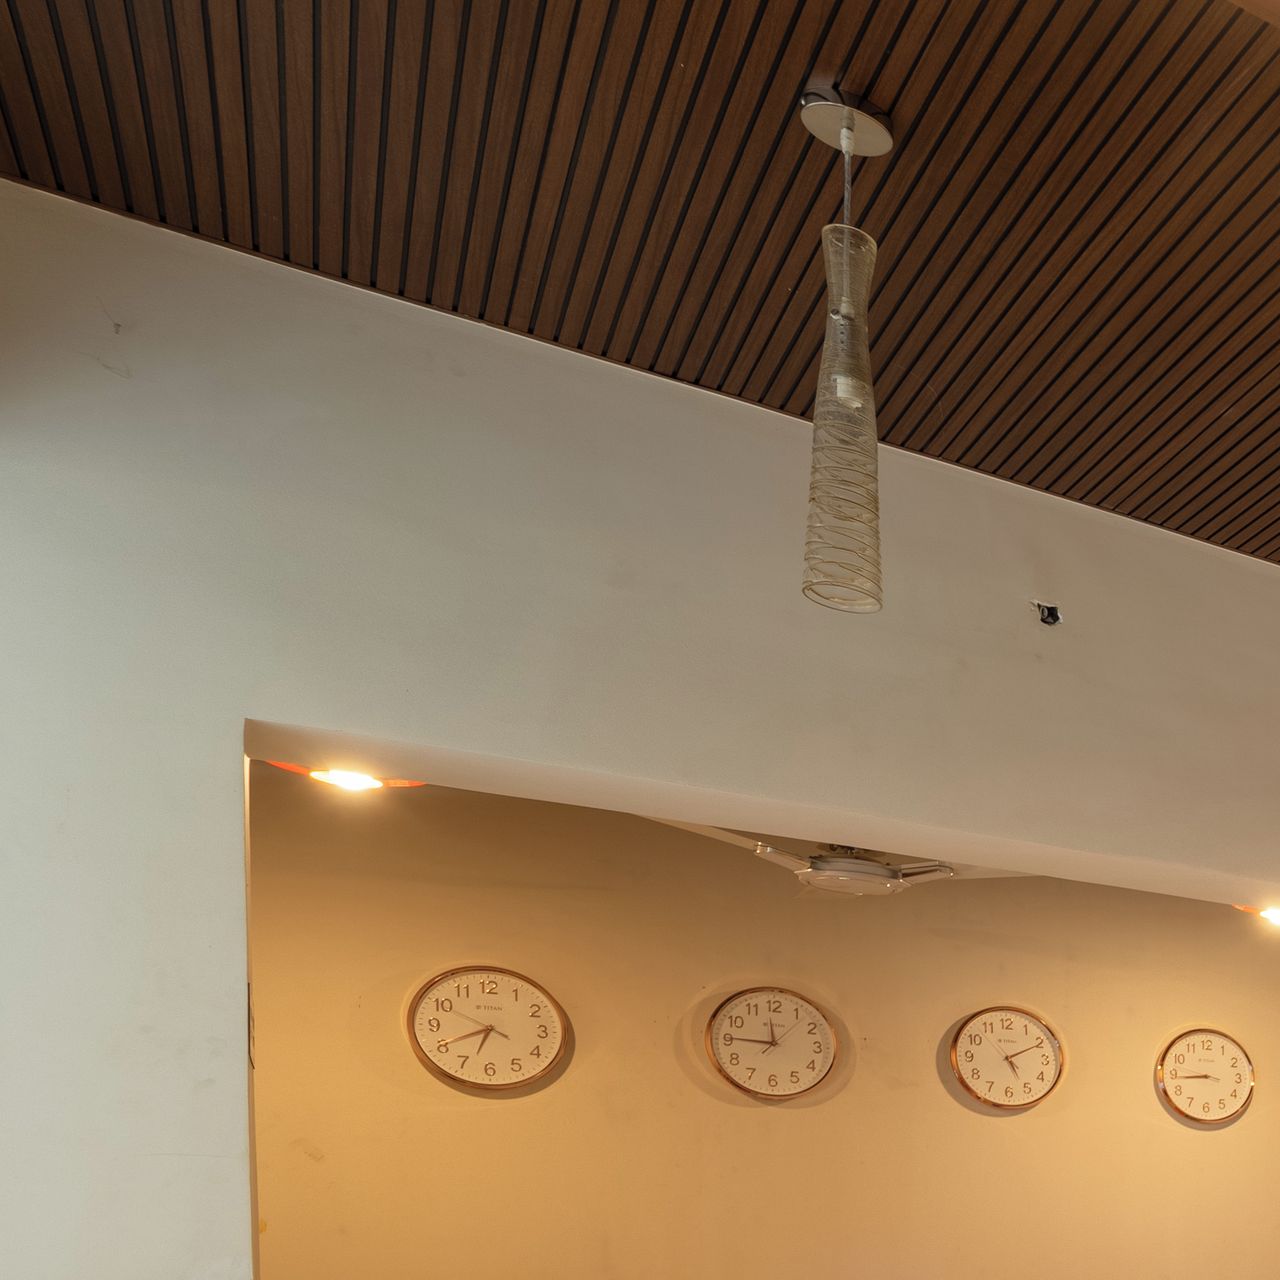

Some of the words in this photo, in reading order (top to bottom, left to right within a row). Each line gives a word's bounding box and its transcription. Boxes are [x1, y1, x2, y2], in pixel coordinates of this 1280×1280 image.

[455, 984, 469, 998] 11
[480, 979, 498, 994] 12
[512, 988, 518, 1002] 1
[434, 998, 452, 1012] 10
[529, 1004, 541, 1017] 2
[746, 1003, 759, 1016] 11
[766, 1000, 782, 1013] 12
[794, 1008, 799, 1020] 1
[428, 1017, 440, 1032] 9
[728, 1016, 744, 1028] 10
[983, 1022, 993, 1033] 11
[1000, 1018, 1013, 1030] 12
[537, 1025, 548, 1038] 3
[808, 1023, 816, 1035] 2
[1024, 1024, 1028, 1035] 1
[723, 1033, 733, 1046] 9
[968, 1034, 982, 1045] 10
[1036, 1037, 1043, 1048] 2
[1201, 1040, 1212, 1050] 12
[530, 1045, 541, 1058] 4
[813, 1041, 822, 1054] 3
[1187, 1043, 1195, 1053] 11
[1221, 1045, 1224, 1055] 1
[457, 1055, 469, 1069] 7
[730, 1053, 739, 1065] 8
[965, 1050, 974, 1062] 9
[1041, 1054, 1049, 1065] 3
[1174, 1054, 1185, 1064] 10
[1231, 1057, 1237, 1067] 2
[484, 1063, 496, 1076] 6
[511, 1059, 522, 1072] 5
[806, 1060, 816, 1072] 4
[746, 1068, 756, 1080] 7
[790, 1071, 799, 1083] 5
[972, 1068, 980, 1080] 8
[1036, 1072, 1044, 1082] 4
[1170, 1069, 1177, 1079] 9
[1235, 1073, 1241, 1083] 3
[768, 1075, 778, 1087] 6
[986, 1081, 994, 1092] 7
[1005, 1087, 1013, 1097] 6
[1023, 1083, 1031, 1094] 5
[1175, 1085, 1182, 1096] 8
[1230, 1090, 1237, 1098] 4
[1187, 1097, 1194, 1108] 7
[1203, 1103, 1209, 1113] 6
[1218, 1099, 1225, 1109] 5
